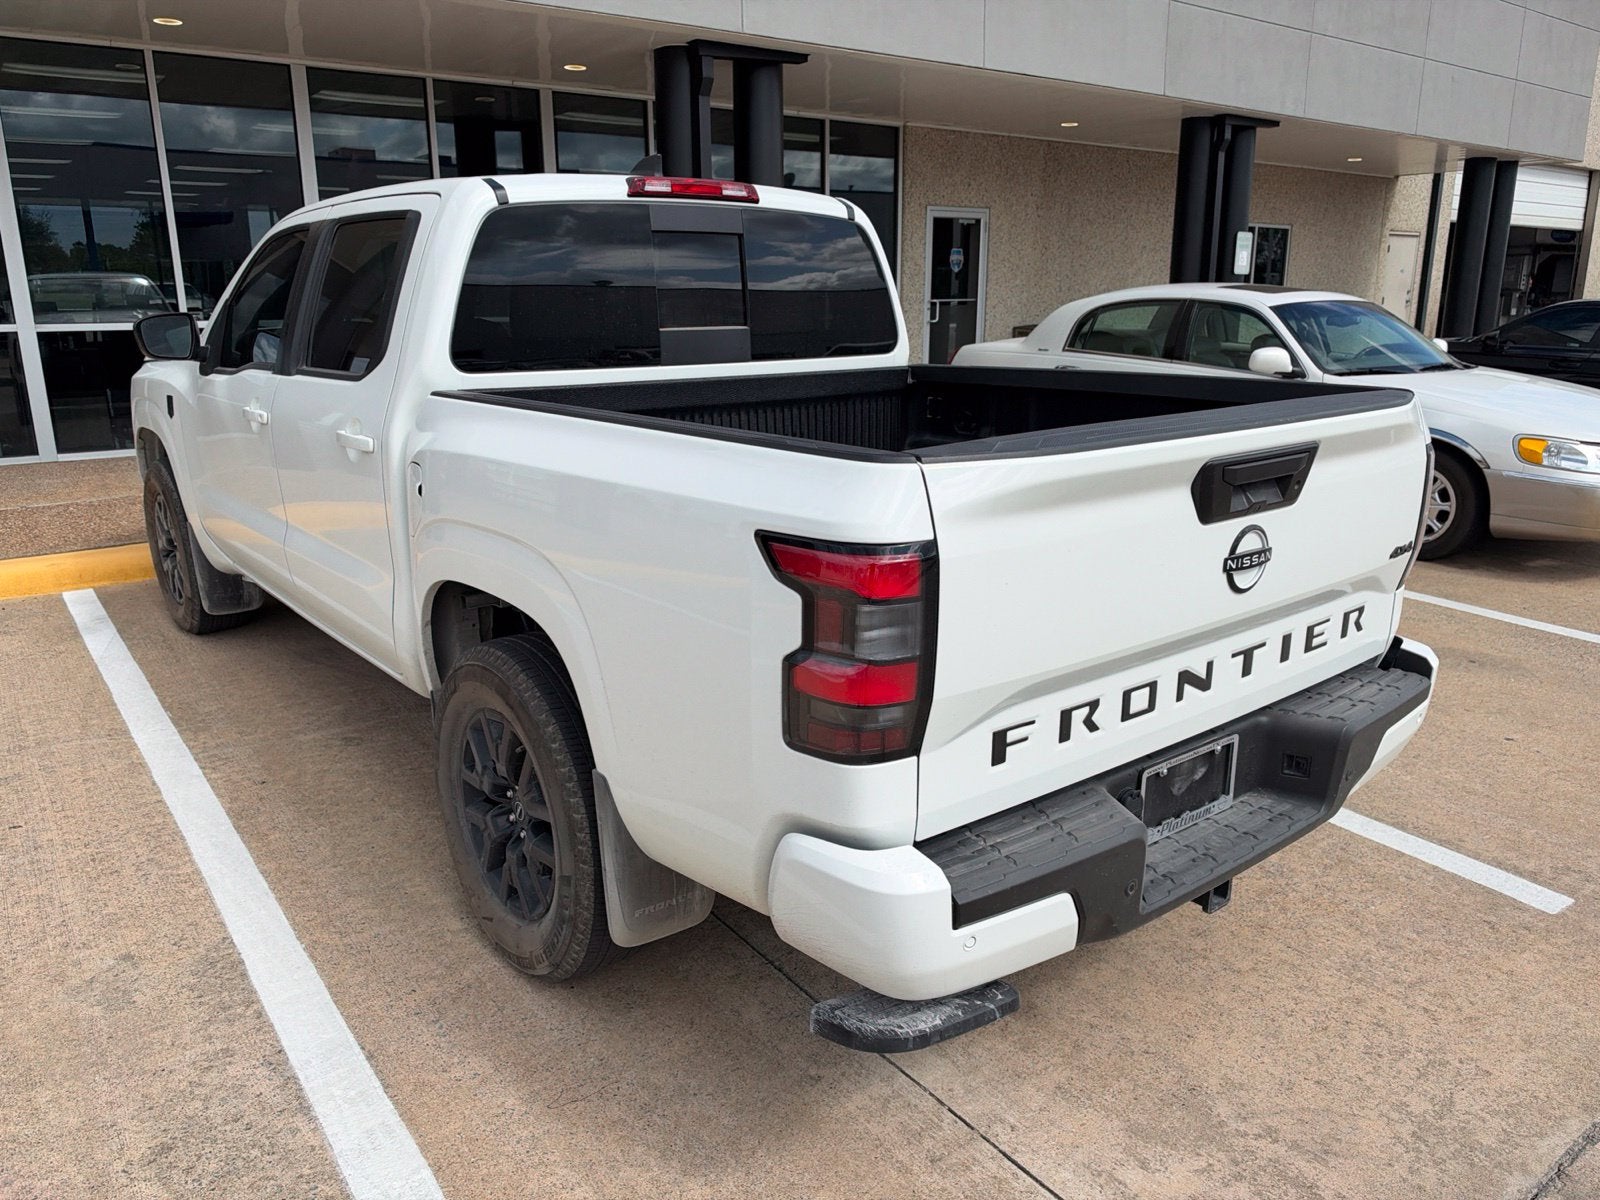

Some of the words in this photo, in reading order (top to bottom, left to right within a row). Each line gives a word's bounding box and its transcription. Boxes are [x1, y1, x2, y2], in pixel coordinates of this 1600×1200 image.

[1226, 551, 1271, 570] NISSAN
[991, 605, 1366, 767] FRONTIER
[1160, 806, 1213, 835] Platinum
